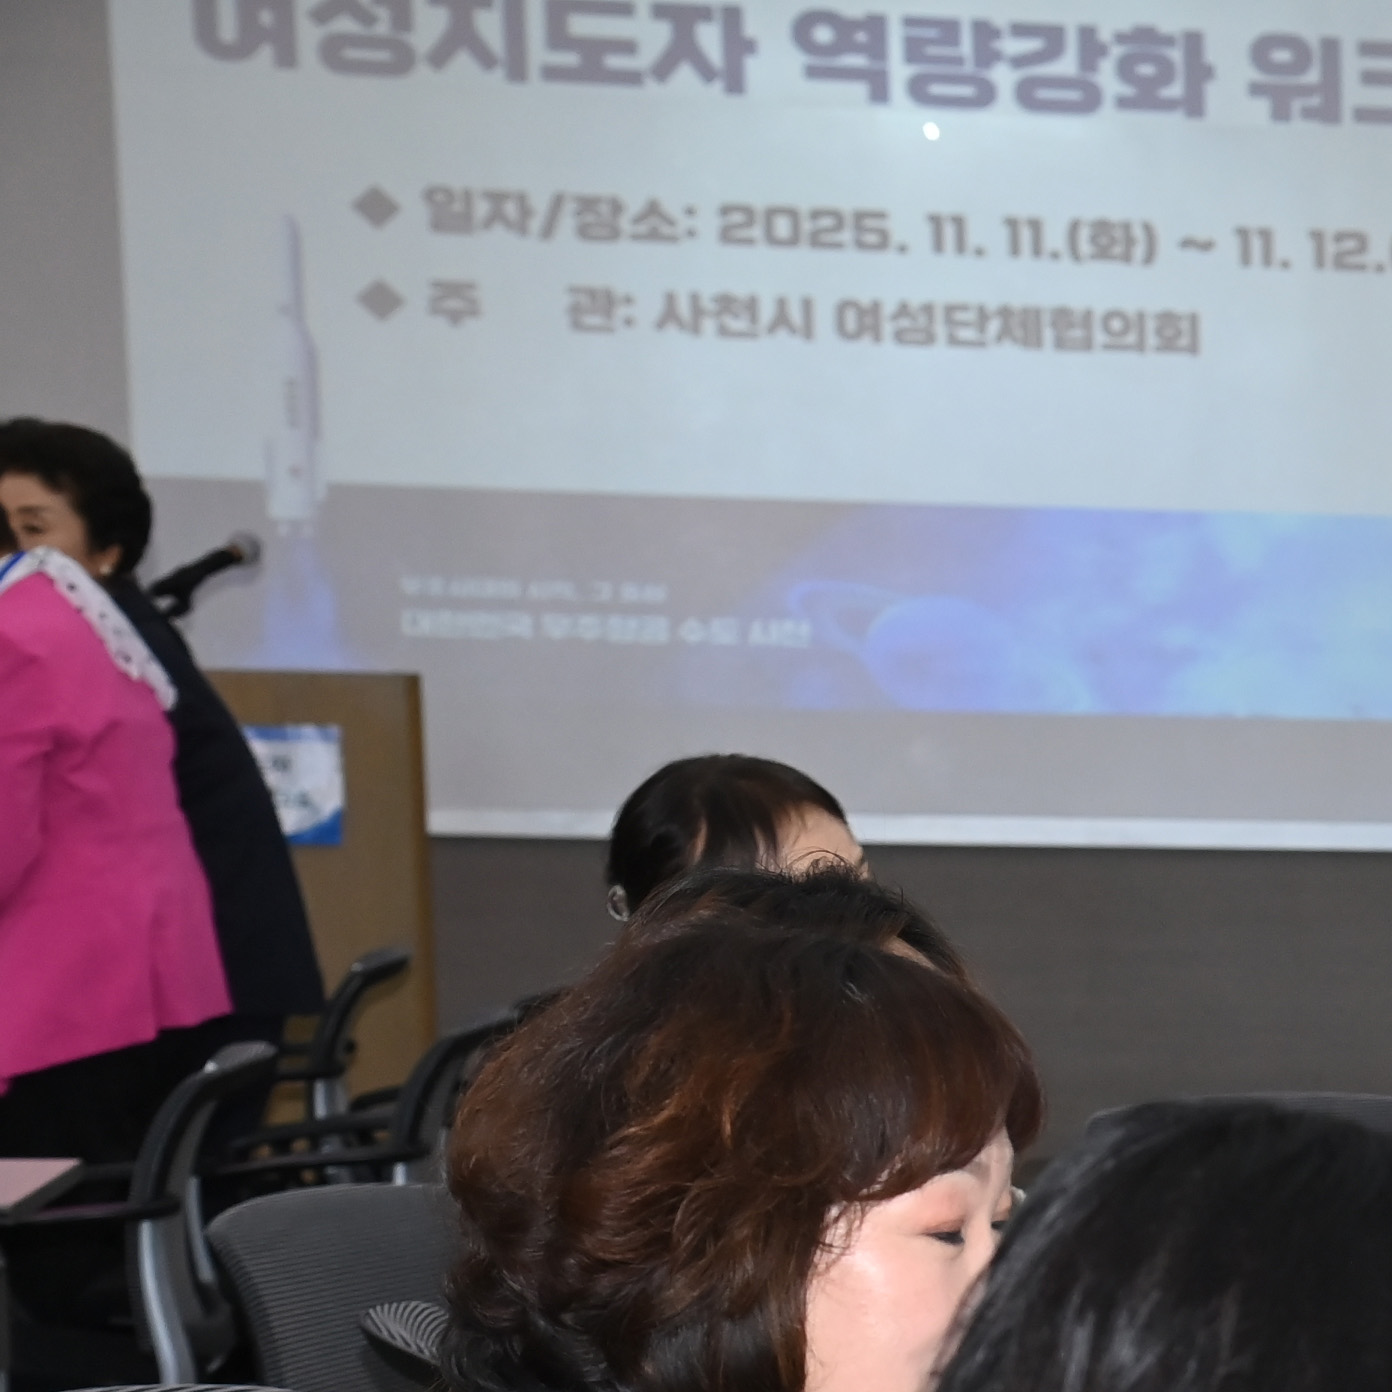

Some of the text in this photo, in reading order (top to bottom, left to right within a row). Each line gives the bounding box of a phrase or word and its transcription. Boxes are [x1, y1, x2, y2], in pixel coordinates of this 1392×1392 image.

[791, 8, 1216, 119] 역량강화
[421, 184, 698, 244] 일자/장소:
[717, 203, 908, 256] 2025.
[427, 280, 483, 327] 주
[654, 290, 815, 341] 사천시
[834, 297, 1201, 355] 여성단체협의회
